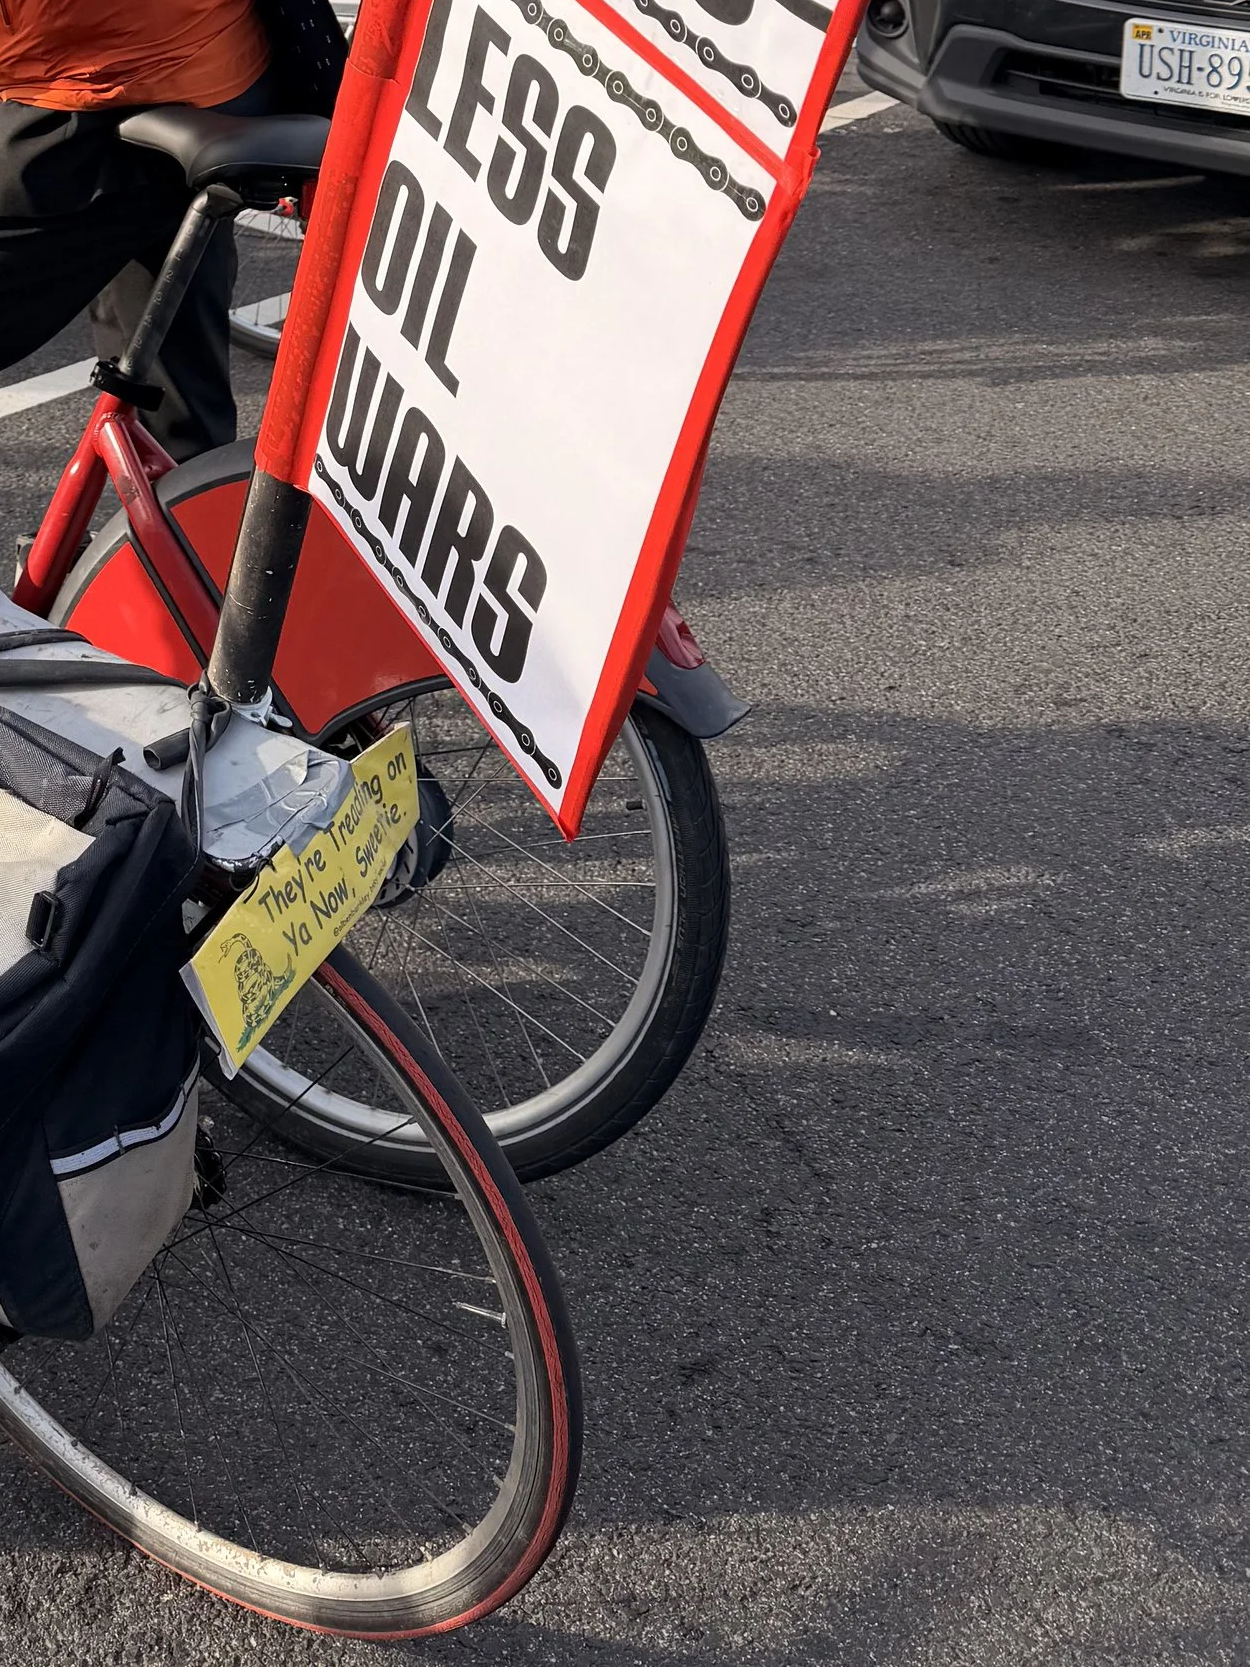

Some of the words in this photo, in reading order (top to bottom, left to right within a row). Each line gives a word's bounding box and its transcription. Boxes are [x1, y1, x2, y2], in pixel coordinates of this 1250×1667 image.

[1138, 43, 1250, 91] USH-89
[1169, 30, 1250, 52] VIRGINIA
[361, 160, 477, 398] OIL
[326, 319, 547, 684] WARS
[258, 848, 327, 925] They're
[323, 772, 382, 853] Treading
[386, 750, 407, 781] on
[282, 920, 312, 957] Ya
[310, 876, 356, 930] Now,
[354, 801, 407, 878] Sweetie.
